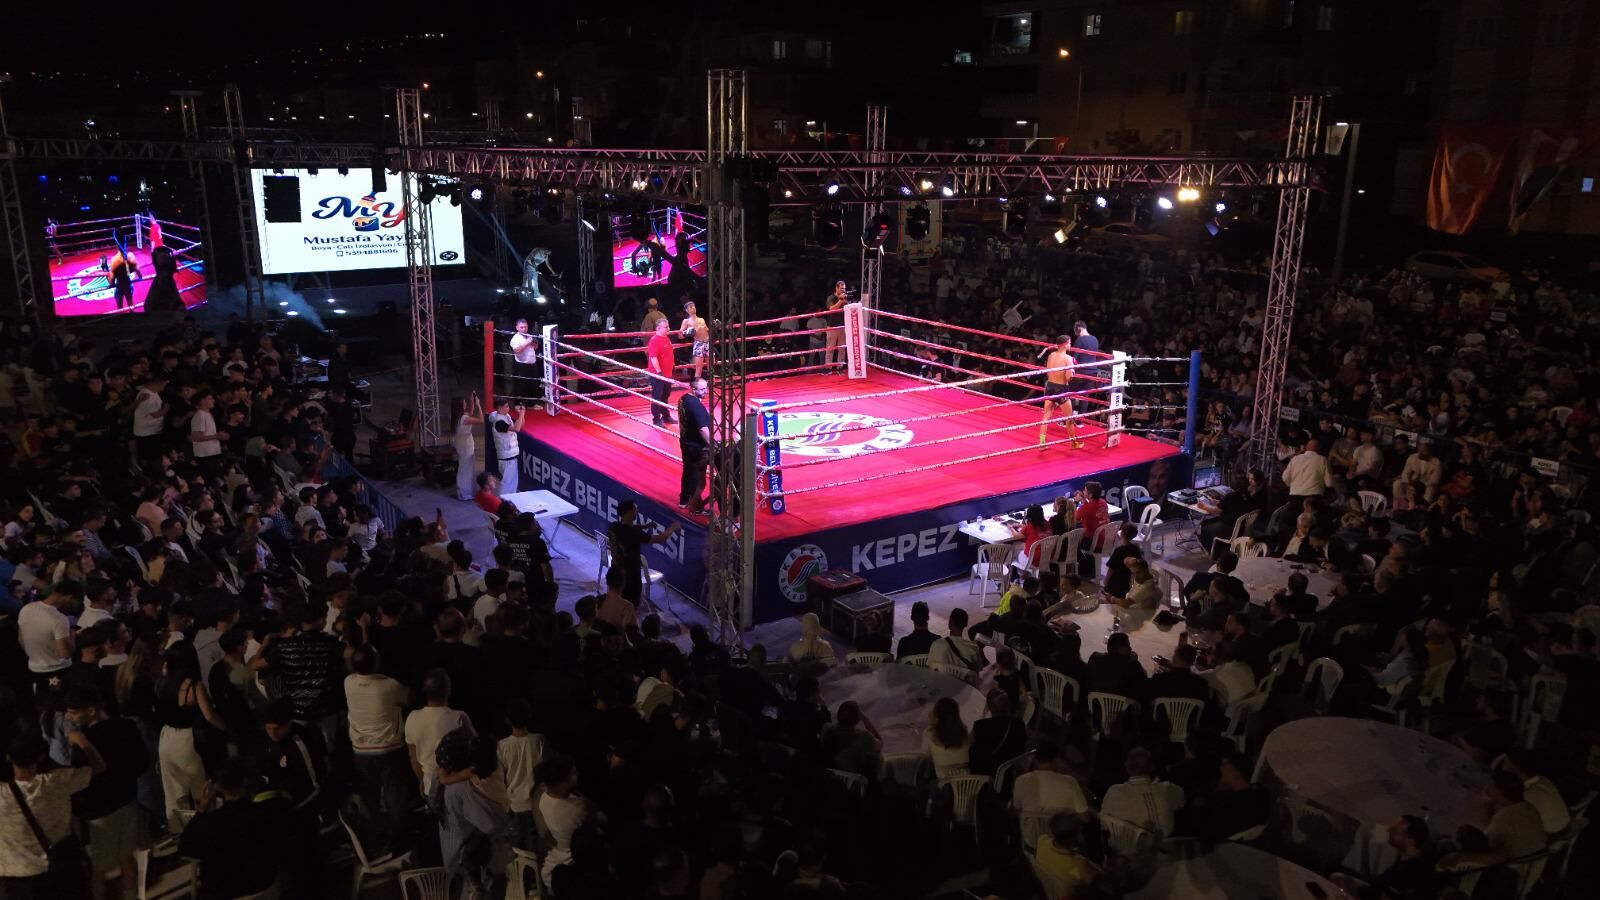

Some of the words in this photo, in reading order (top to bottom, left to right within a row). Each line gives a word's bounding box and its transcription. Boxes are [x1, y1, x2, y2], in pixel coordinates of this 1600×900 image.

[303, 234, 371, 245] Mustafa
[766, 419, 777, 447] KEPZ
[522, 451, 572, 499] KEPEZ
[574, 477, 686, 565] BELEYESİ
[851, 523, 960, 574] KEPEZ
